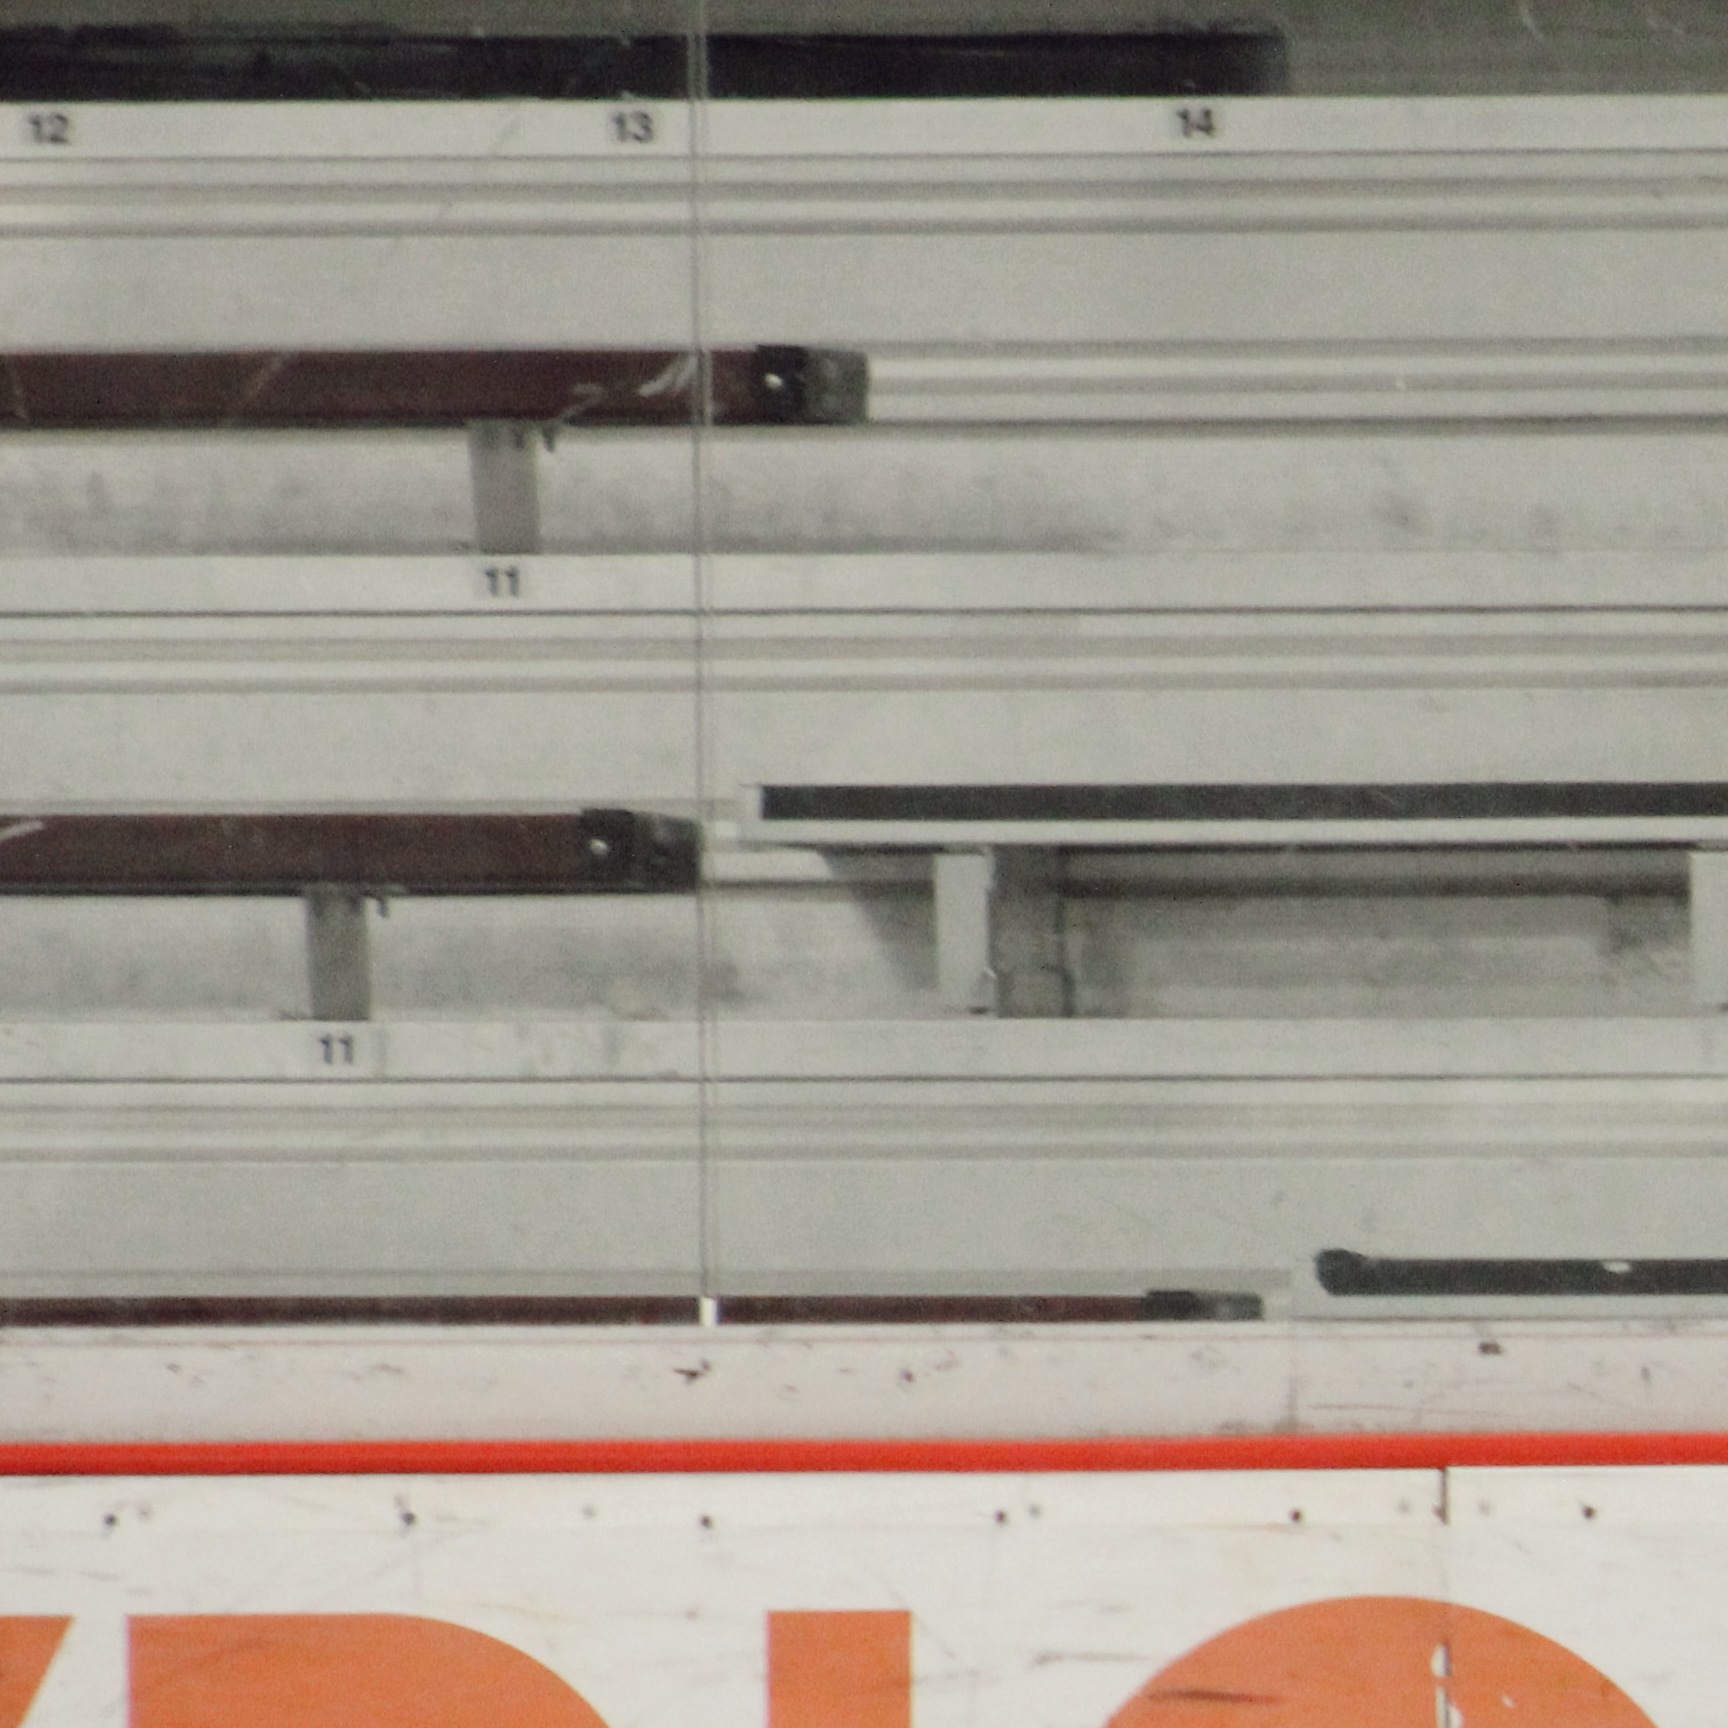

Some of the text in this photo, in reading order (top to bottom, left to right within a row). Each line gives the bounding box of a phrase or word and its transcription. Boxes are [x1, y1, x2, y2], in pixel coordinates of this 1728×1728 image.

[29, 113, 70, 145] 12
[613, 111, 653, 143] 13
[1176, 108, 1216, 138] 14
[484, 566, 521, 597] 11
[318, 1034, 355, 1065] 11
